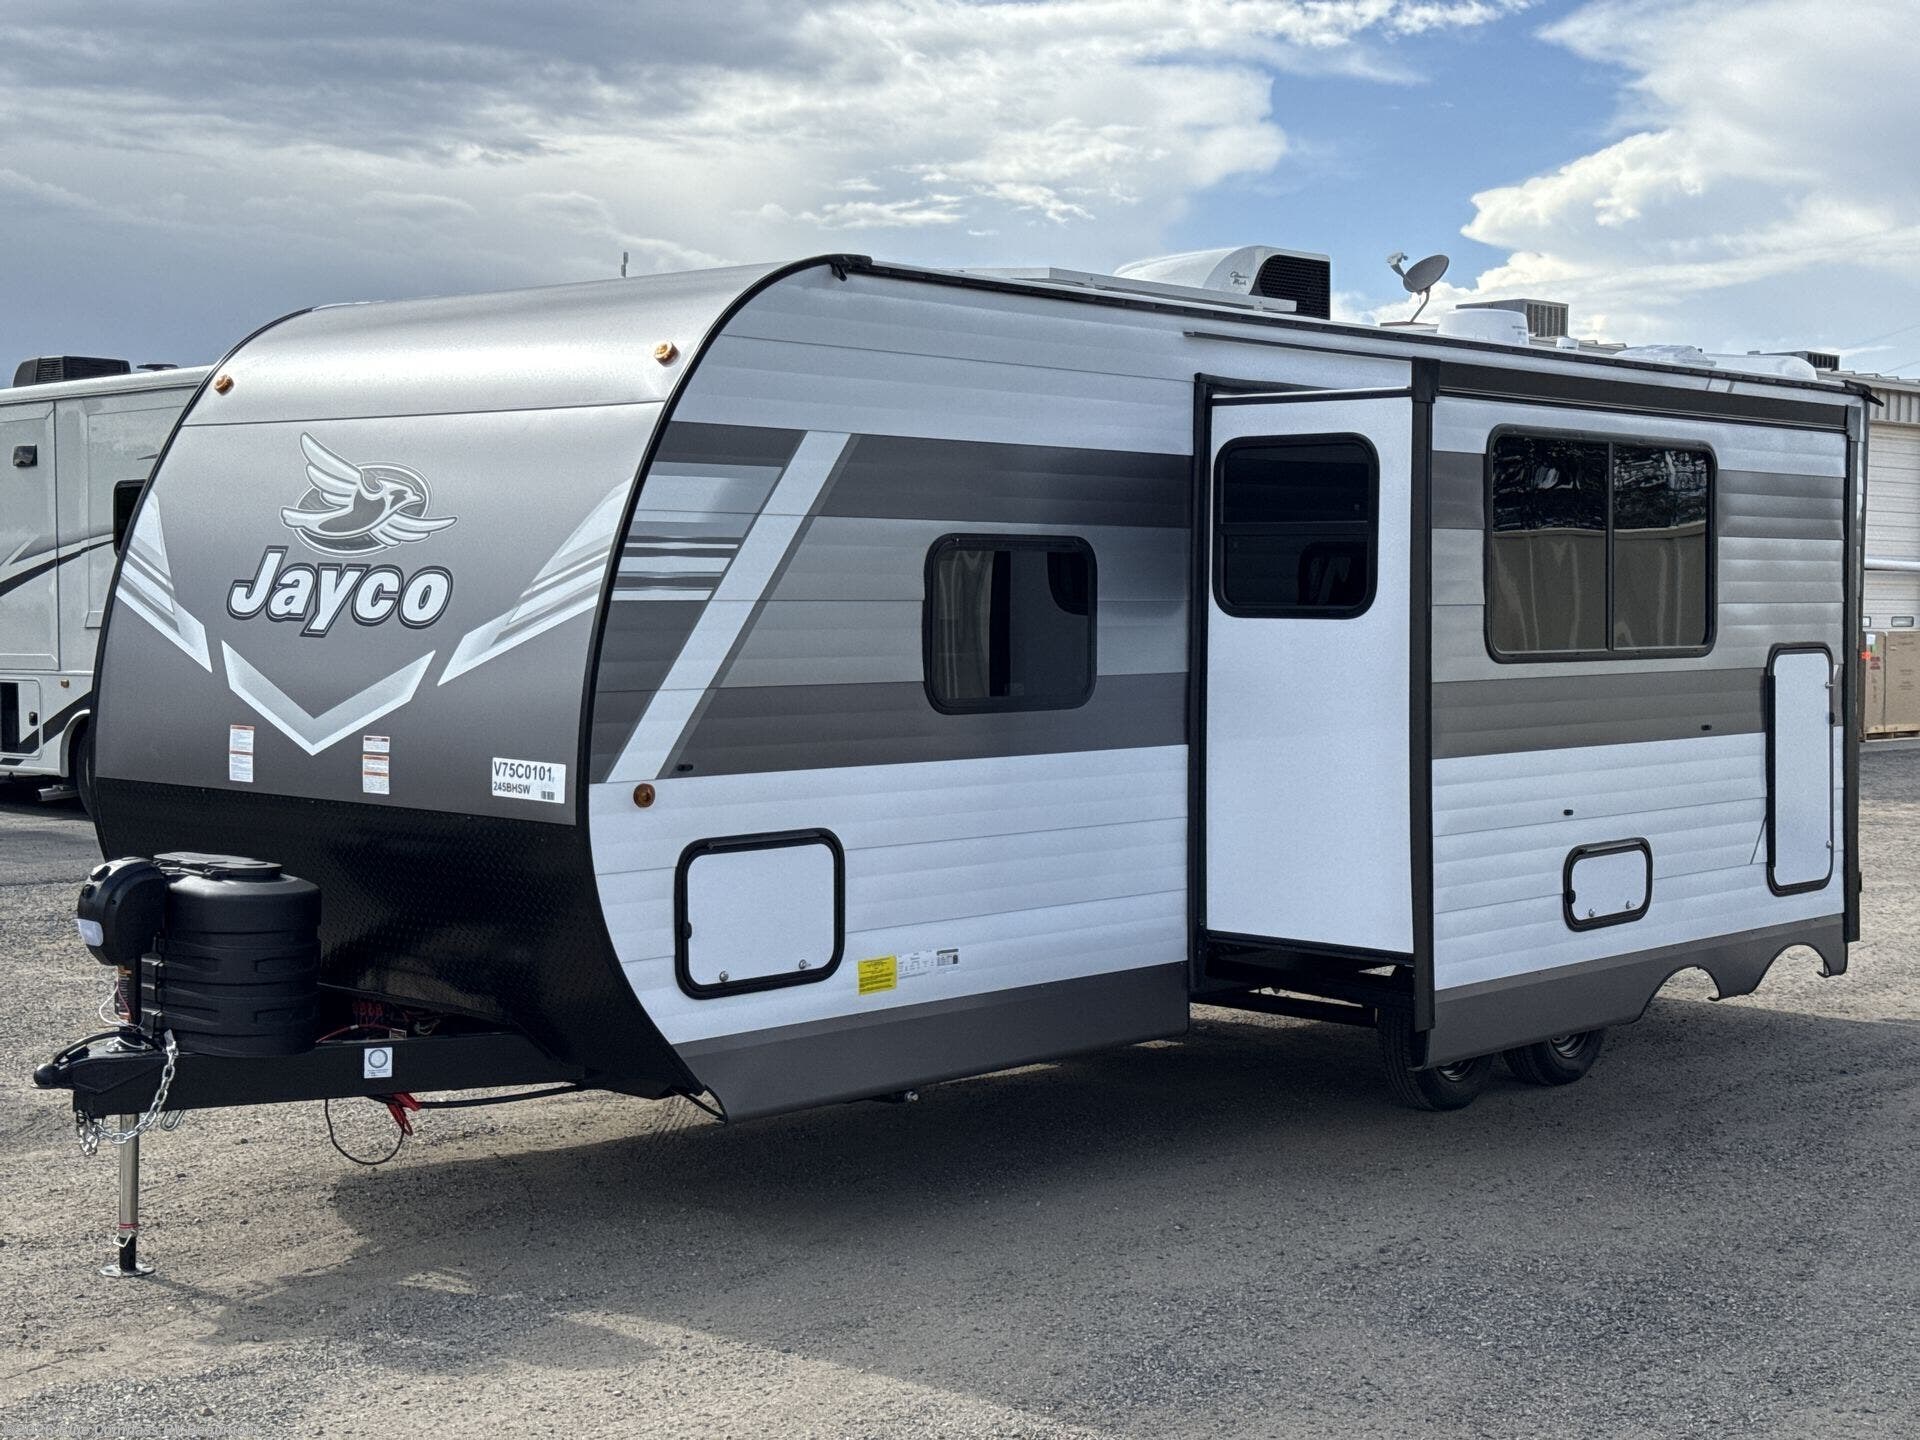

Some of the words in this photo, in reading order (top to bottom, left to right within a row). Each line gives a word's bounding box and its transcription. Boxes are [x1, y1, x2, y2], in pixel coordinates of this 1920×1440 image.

[227, 546, 453, 638] Jayco
[493, 761, 553, 782] V75C0101
[493, 781, 531, 795] 245BHSW
